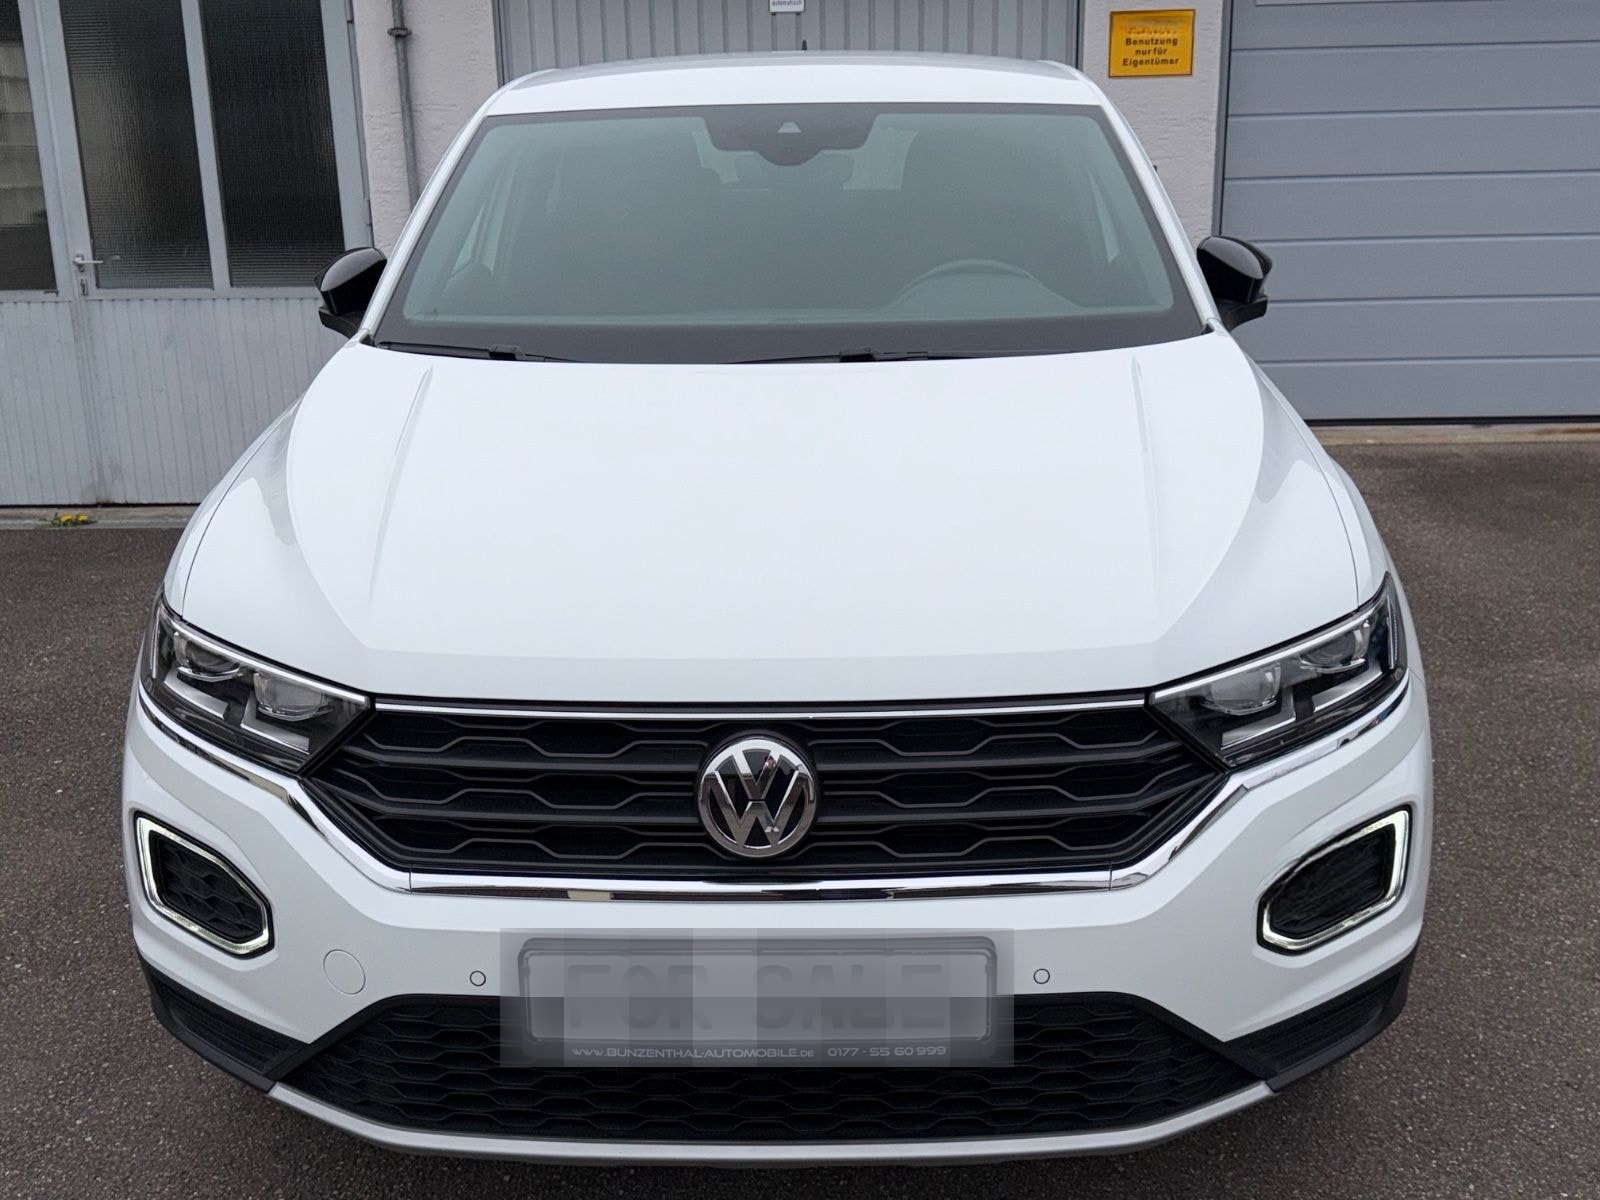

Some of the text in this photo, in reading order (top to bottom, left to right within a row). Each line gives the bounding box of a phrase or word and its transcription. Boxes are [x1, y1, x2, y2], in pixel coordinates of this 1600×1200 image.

[1125, 37, 1178, 46] Benutzung
[1153, 46, 1168, 56] für
[1122, 57, 1179, 68] Eigentümer
[567, 964, 946, 1030] FOR SALE
[827, 1047, 859, 1057] 0177
[869, 1047, 890, 1057] 55
[894, 1046, 913, 1056] 60
[916, 1045, 947, 1056] 999
